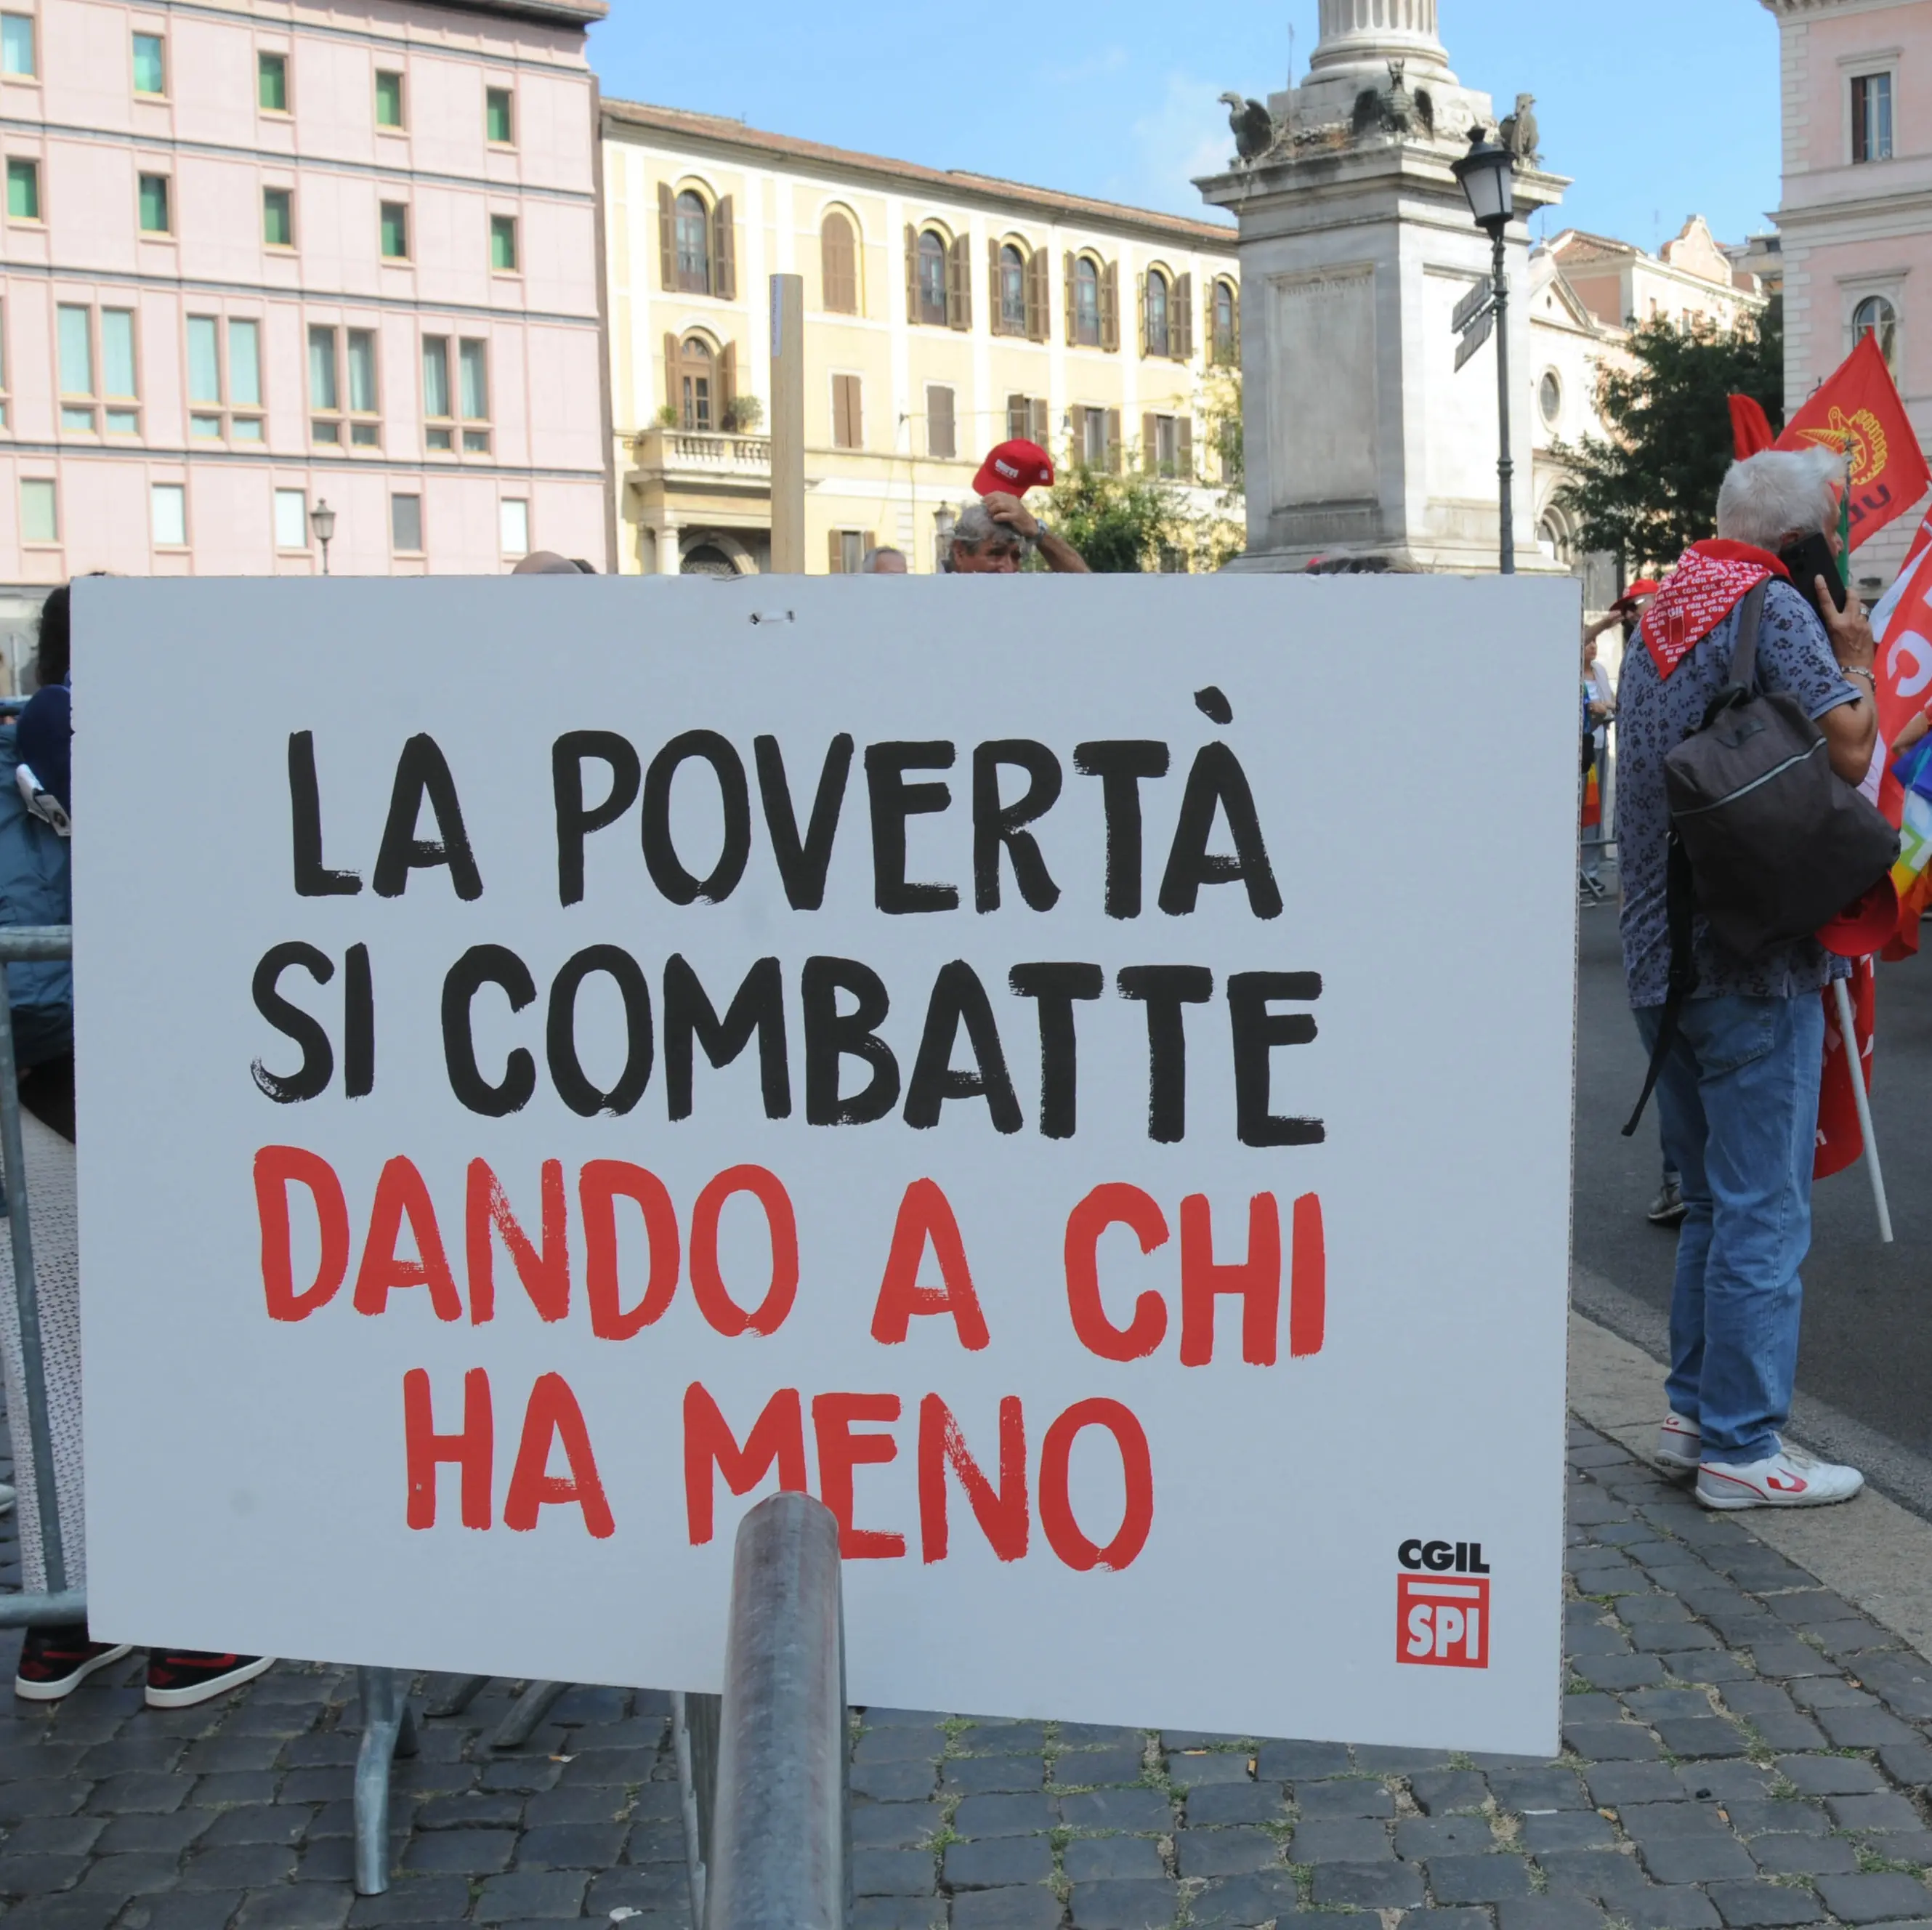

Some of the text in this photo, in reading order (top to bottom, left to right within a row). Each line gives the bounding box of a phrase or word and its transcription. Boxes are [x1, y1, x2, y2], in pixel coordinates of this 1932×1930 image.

[288, 687, 1283, 920] LA POVERTÀ
[251, 942, 1325, 1147] SI COMBATTE
[254, 1145, 1326, 1367] DANDO A CHI
[404, 1368, 1154, 1572] HA MENO
[1398, 1538, 1490, 1573] CGIL
[1407, 1604, 1479, 1660] SPI
